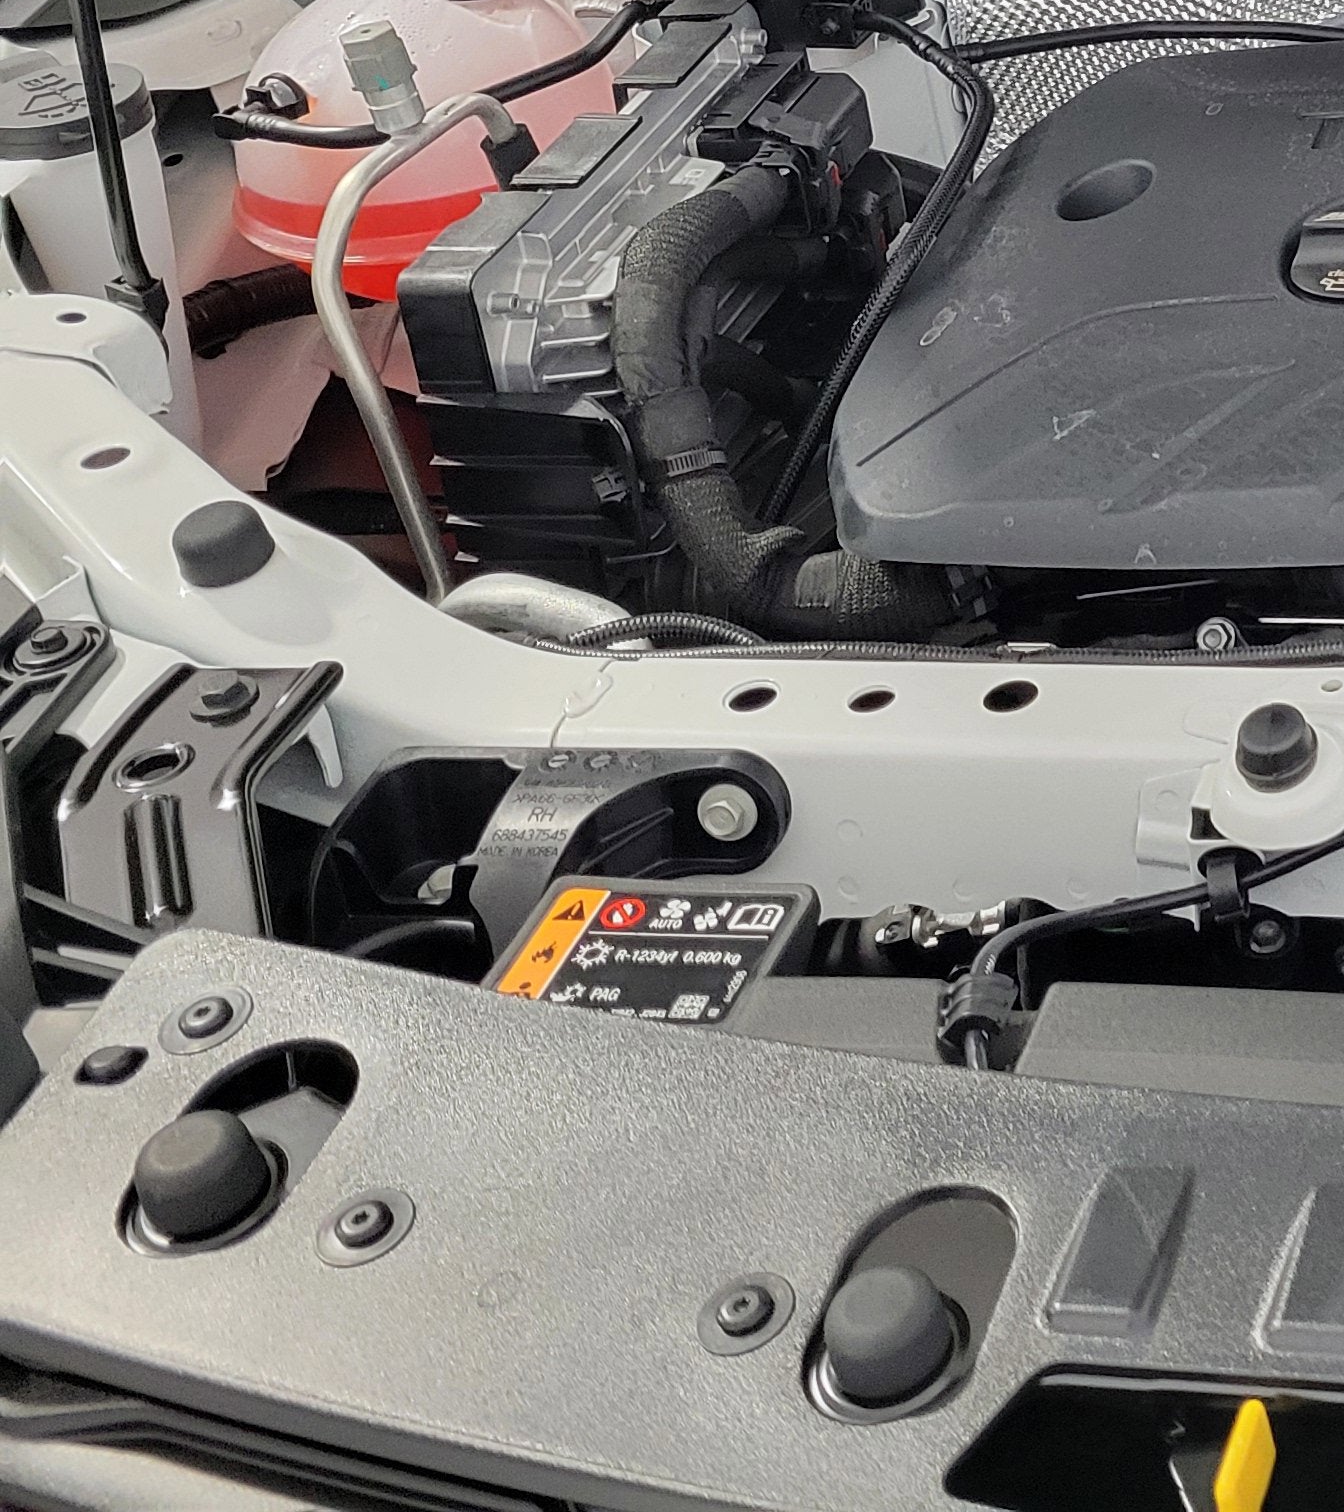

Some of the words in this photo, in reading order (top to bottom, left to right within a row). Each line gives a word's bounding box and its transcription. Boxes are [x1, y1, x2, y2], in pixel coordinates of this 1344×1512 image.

[527, 806, 558, 822] RH
[649, 918, 683, 930] AUTO
[614, 949, 678, 966] R-1234yf
[682, 951, 722, 964] 0.600
[723, 952, 742, 967] kg
[589, 986, 621, 1002] PAG
